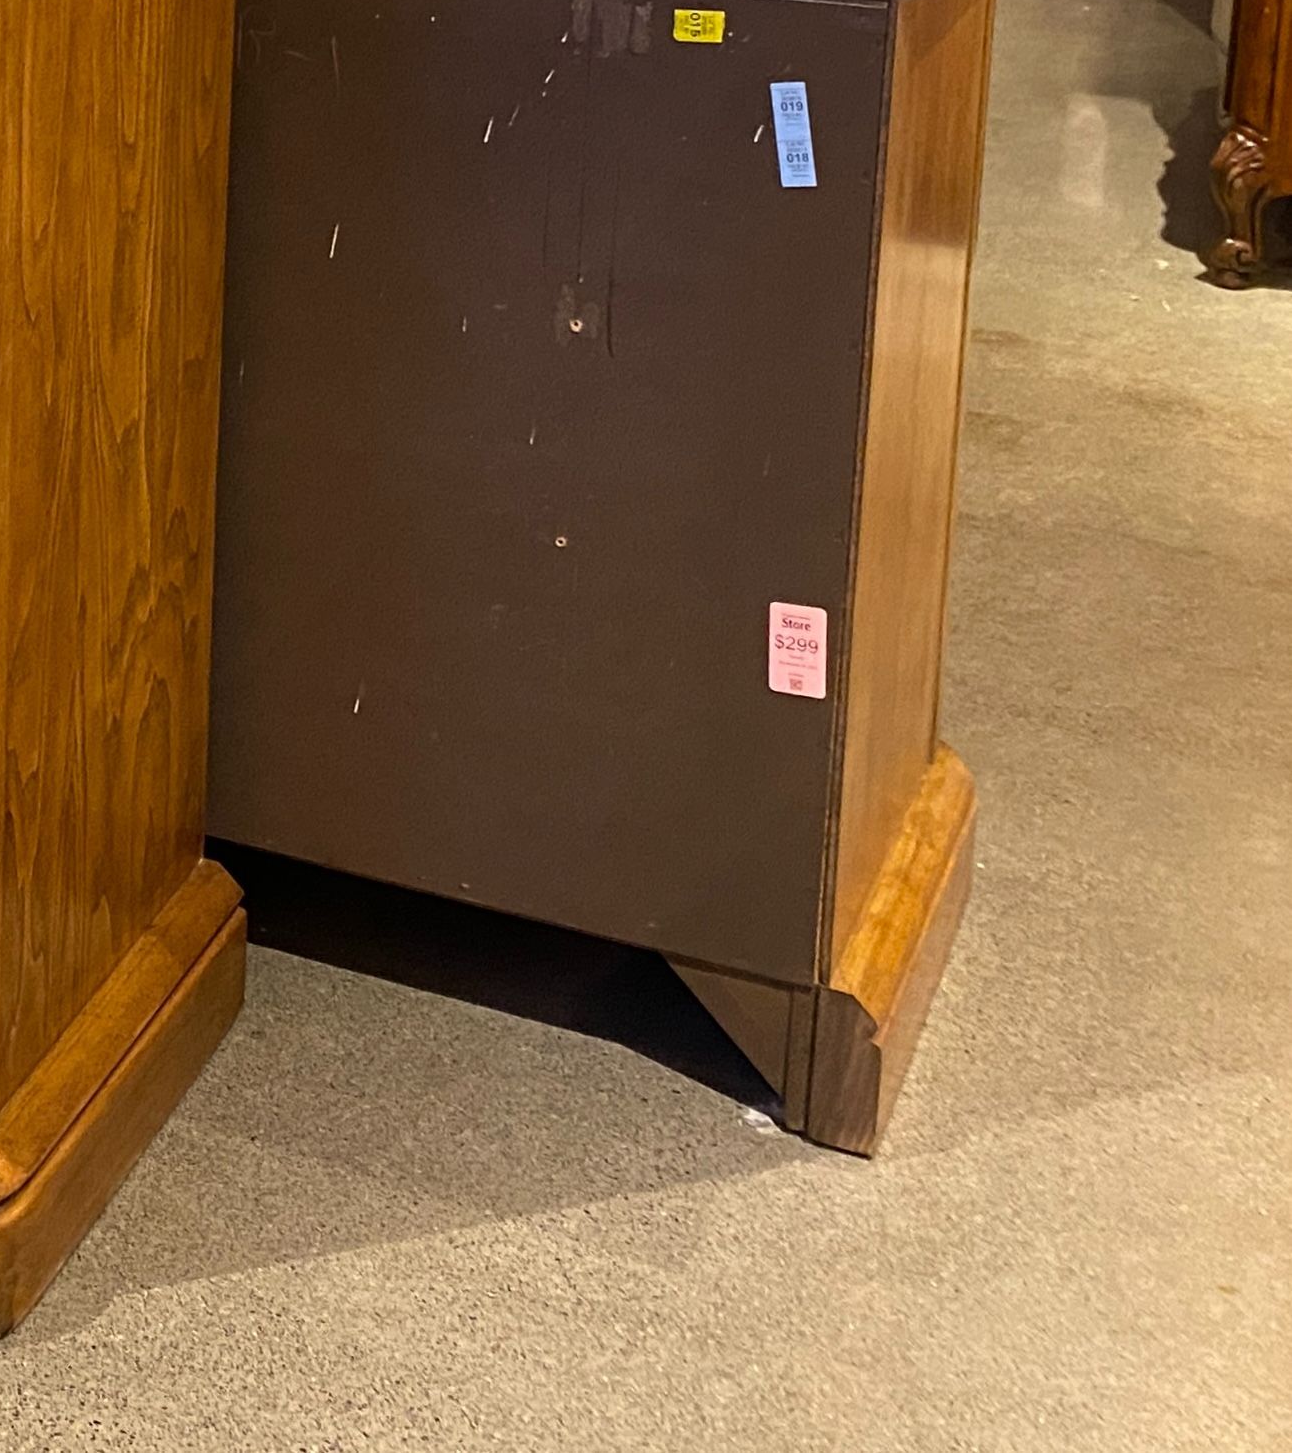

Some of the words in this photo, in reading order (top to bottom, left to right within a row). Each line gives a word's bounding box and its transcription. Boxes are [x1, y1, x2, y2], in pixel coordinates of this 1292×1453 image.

[780, 100, 803, 111] 019
[786, 153, 809, 163] 018
[781, 617, 811, 631] Store
[775, 634, 818, 654] $299
